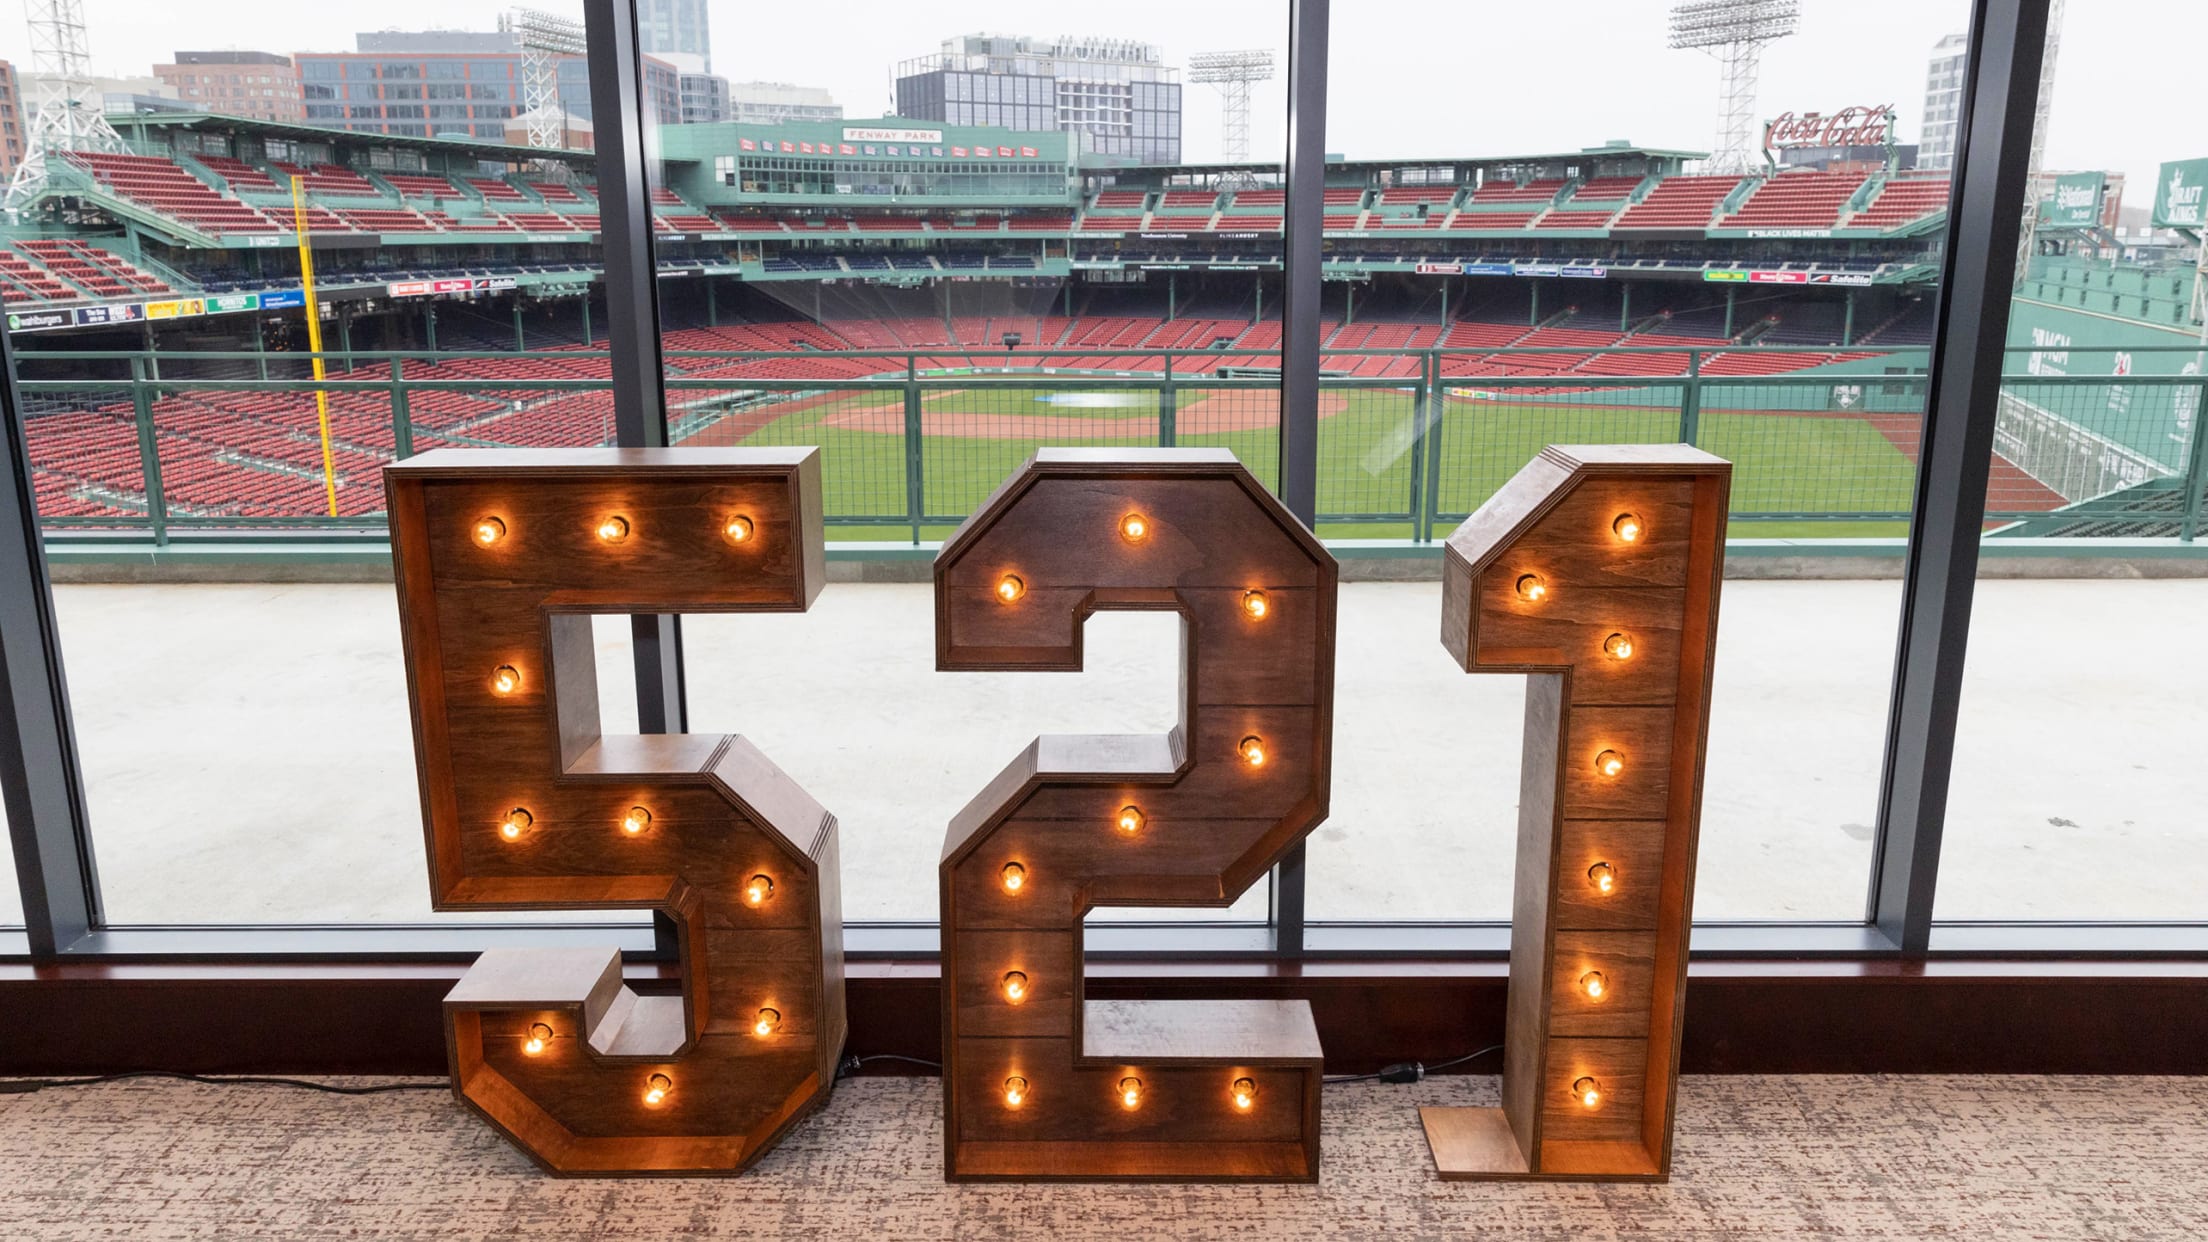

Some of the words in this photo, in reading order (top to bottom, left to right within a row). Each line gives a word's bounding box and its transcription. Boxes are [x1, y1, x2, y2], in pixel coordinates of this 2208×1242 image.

[1765, 104, 1894, 149] Coca-Cola
[849, 130, 898, 141] FENWAY
[904, 132, 937, 142] PARK
[1757, 230, 1779, 238] BLACK
[1781, 230, 1801, 238] LIVES
[1803, 230, 1831, 238] MATTER
[1829, 273, 1871, 285] Safelite
